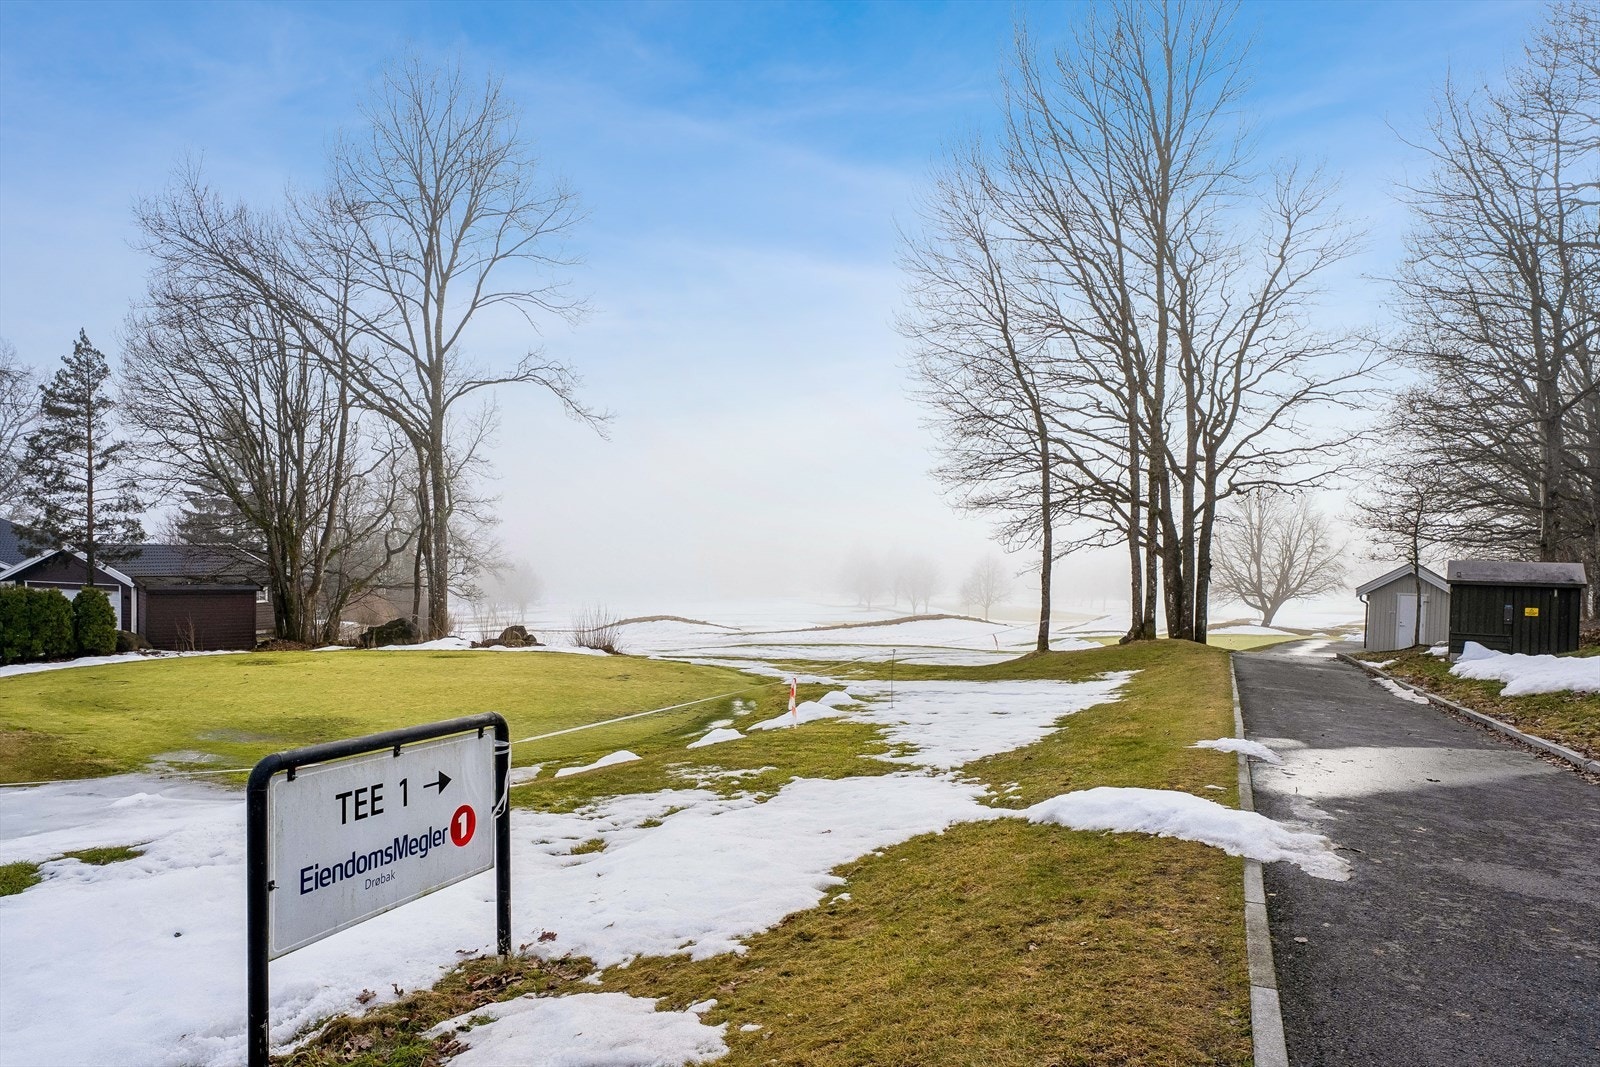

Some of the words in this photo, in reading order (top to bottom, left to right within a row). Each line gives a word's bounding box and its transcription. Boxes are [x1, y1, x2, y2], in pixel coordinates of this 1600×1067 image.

[335, 783, 384, 825] TEE
[399, 778, 408, 807] 1
[300, 826, 448, 895] EiendomsMegler
[364, 870, 396, 890] Drøbak
